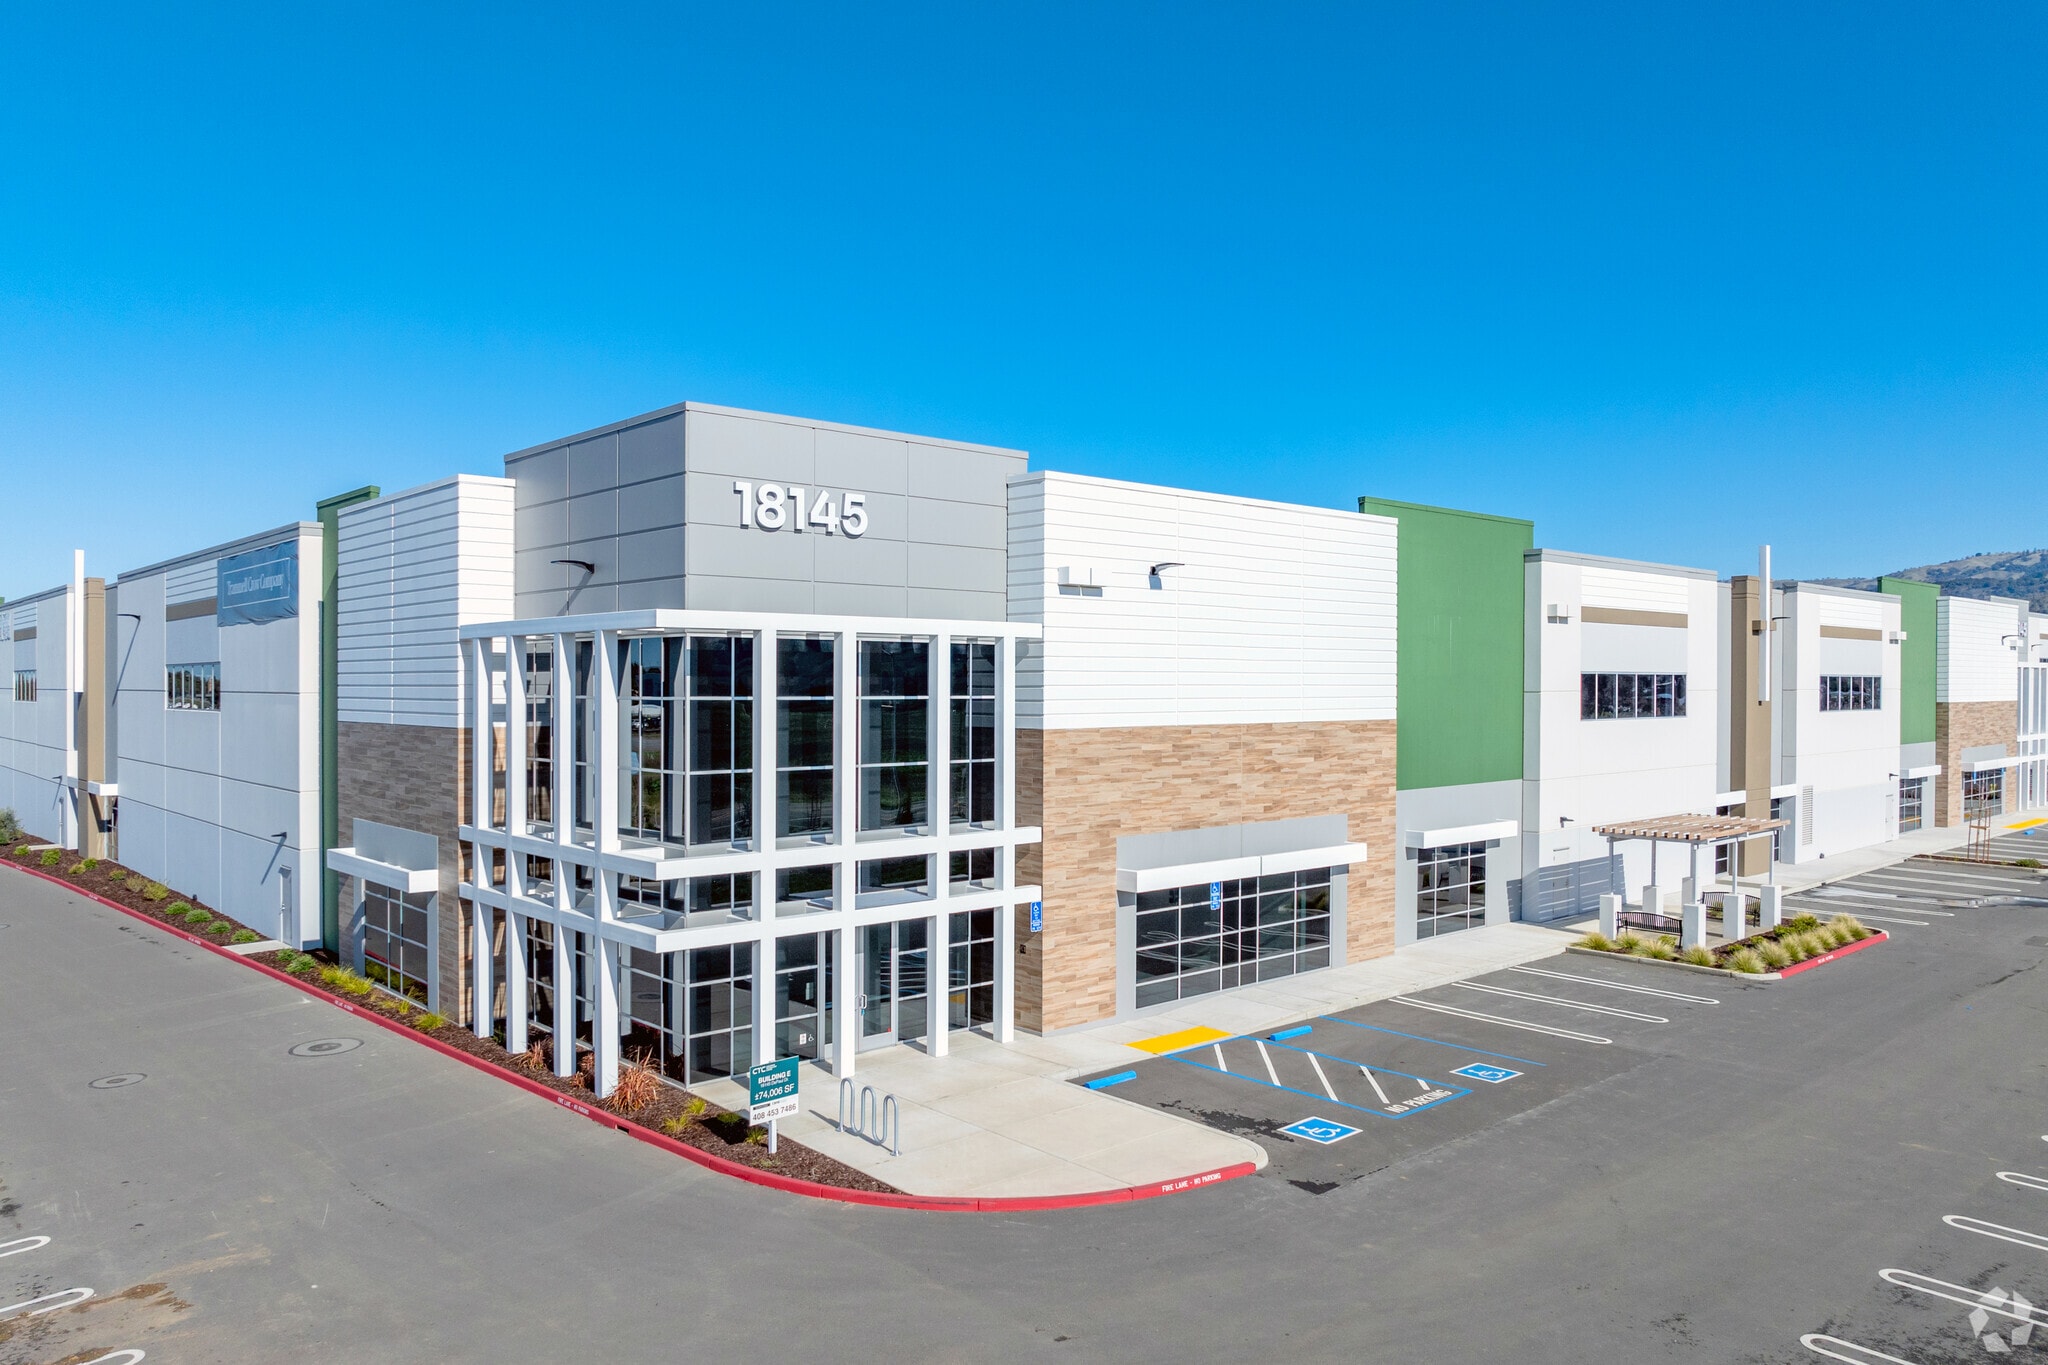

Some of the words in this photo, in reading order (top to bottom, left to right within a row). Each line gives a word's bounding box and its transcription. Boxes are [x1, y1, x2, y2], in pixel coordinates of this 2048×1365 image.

[733, 481, 869, 539] 18145
[758, 1072, 786, 1084] BUILDING
[784, 1083, 795, 1094] SF
[1384, 1104, 1410, 1113] NO
[1401, 1089, 1453, 1107] PARKING
[752, 1111, 766, 1121] 408
[766, 1108, 779, 1117] 453
[1161, 1183, 1174, 1193] FIRE
[1175, 1180, 1189, 1189] LANE
[1193, 1177, 1202, 1185] NO
[1202, 1173, 1221, 1183] PARKING
